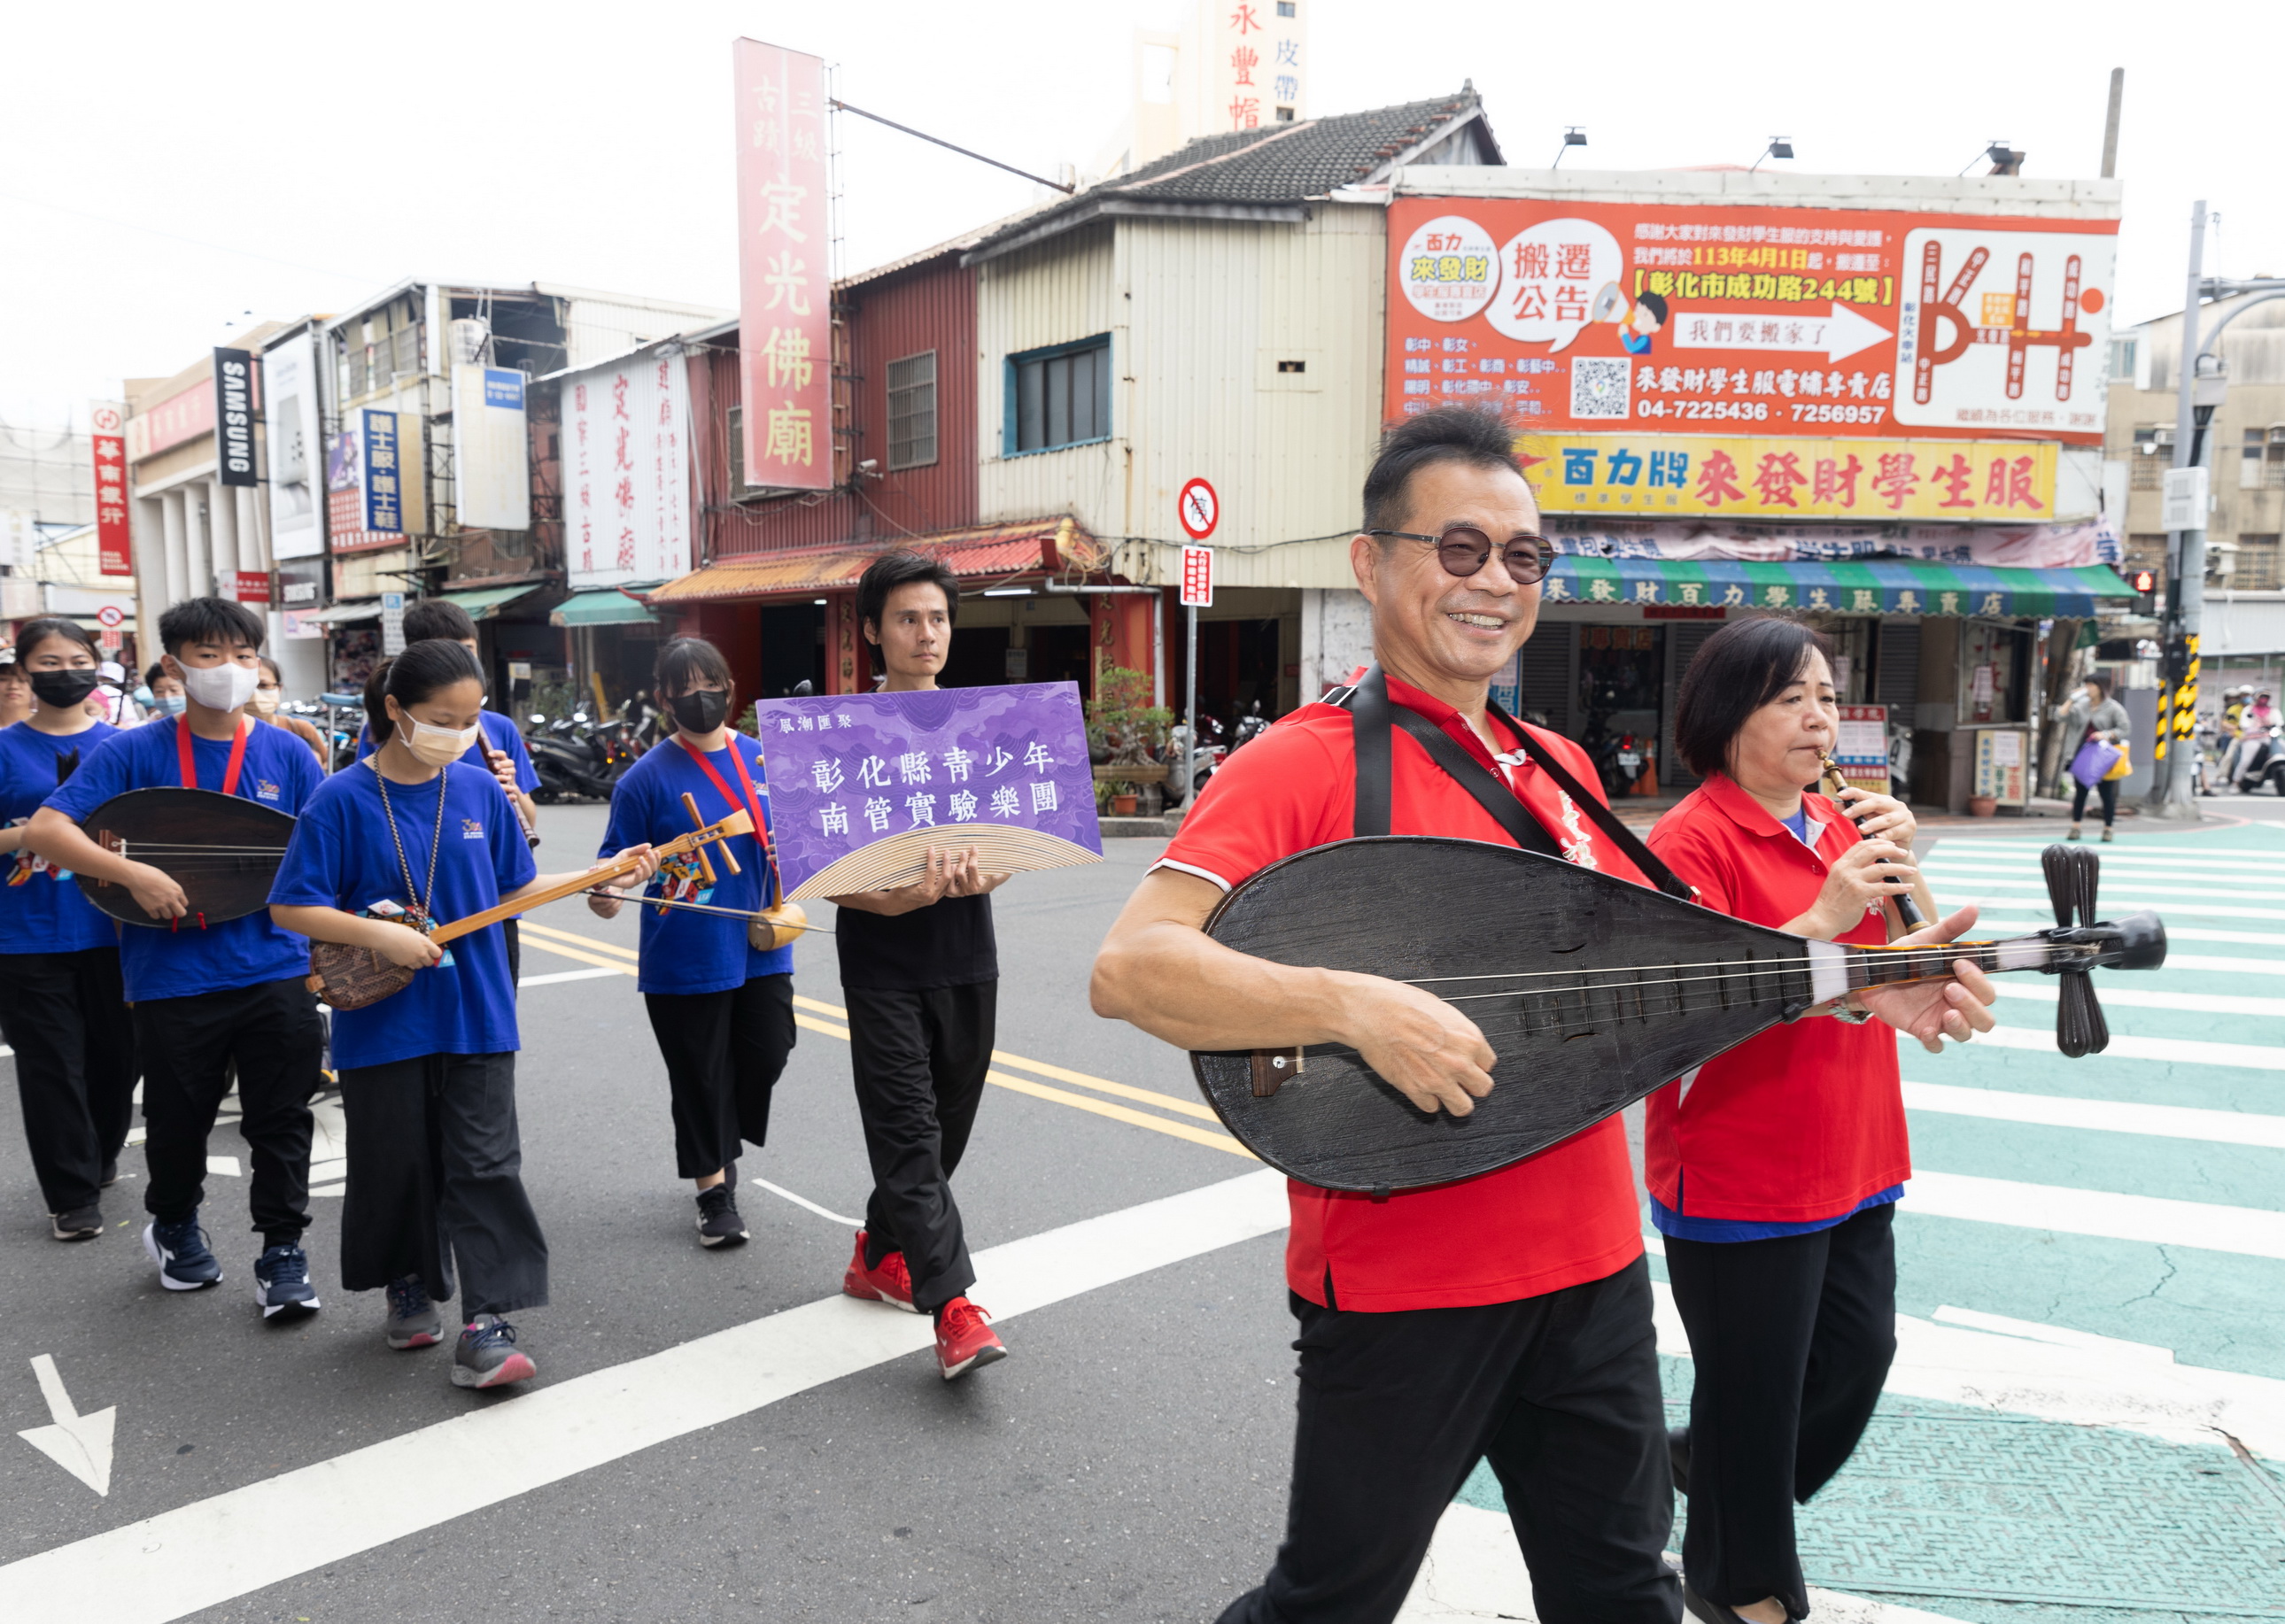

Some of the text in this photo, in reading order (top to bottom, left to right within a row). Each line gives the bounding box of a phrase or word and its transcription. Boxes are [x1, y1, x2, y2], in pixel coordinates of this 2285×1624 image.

[1274, 39, 1298, 101] 皮帶
[1427, 233, 1462, 251] 百力
[1514, 243, 1592, 281] 搬遷
[1411, 255, 1489, 282] 來發財
[760, 173, 813, 469] 定光佛廟
[1512, 284, 1590, 322] 公告
[1689, 320, 1827, 345] 我們要搬家了
[1916, 357, 1931, 402] 中正路
[223, 360, 250, 474] SAMSUNG
[1638, 398, 1769, 421] 04-7225436
[1790, 403, 1886, 424] 7256957
[97, 439, 126, 525] 華南銀行
[1562, 448, 1689, 489] 百力牌
[1693, 448, 2045, 512] 來發財學生服
[1575, 492, 1678, 507] 標準學生服
[1546, 576, 2005, 615] 來發財百力學生服專賣店
[810, 741, 1055, 795] 彰化縣青少年
[818, 780, 1058, 839] 南管實驗樂團
